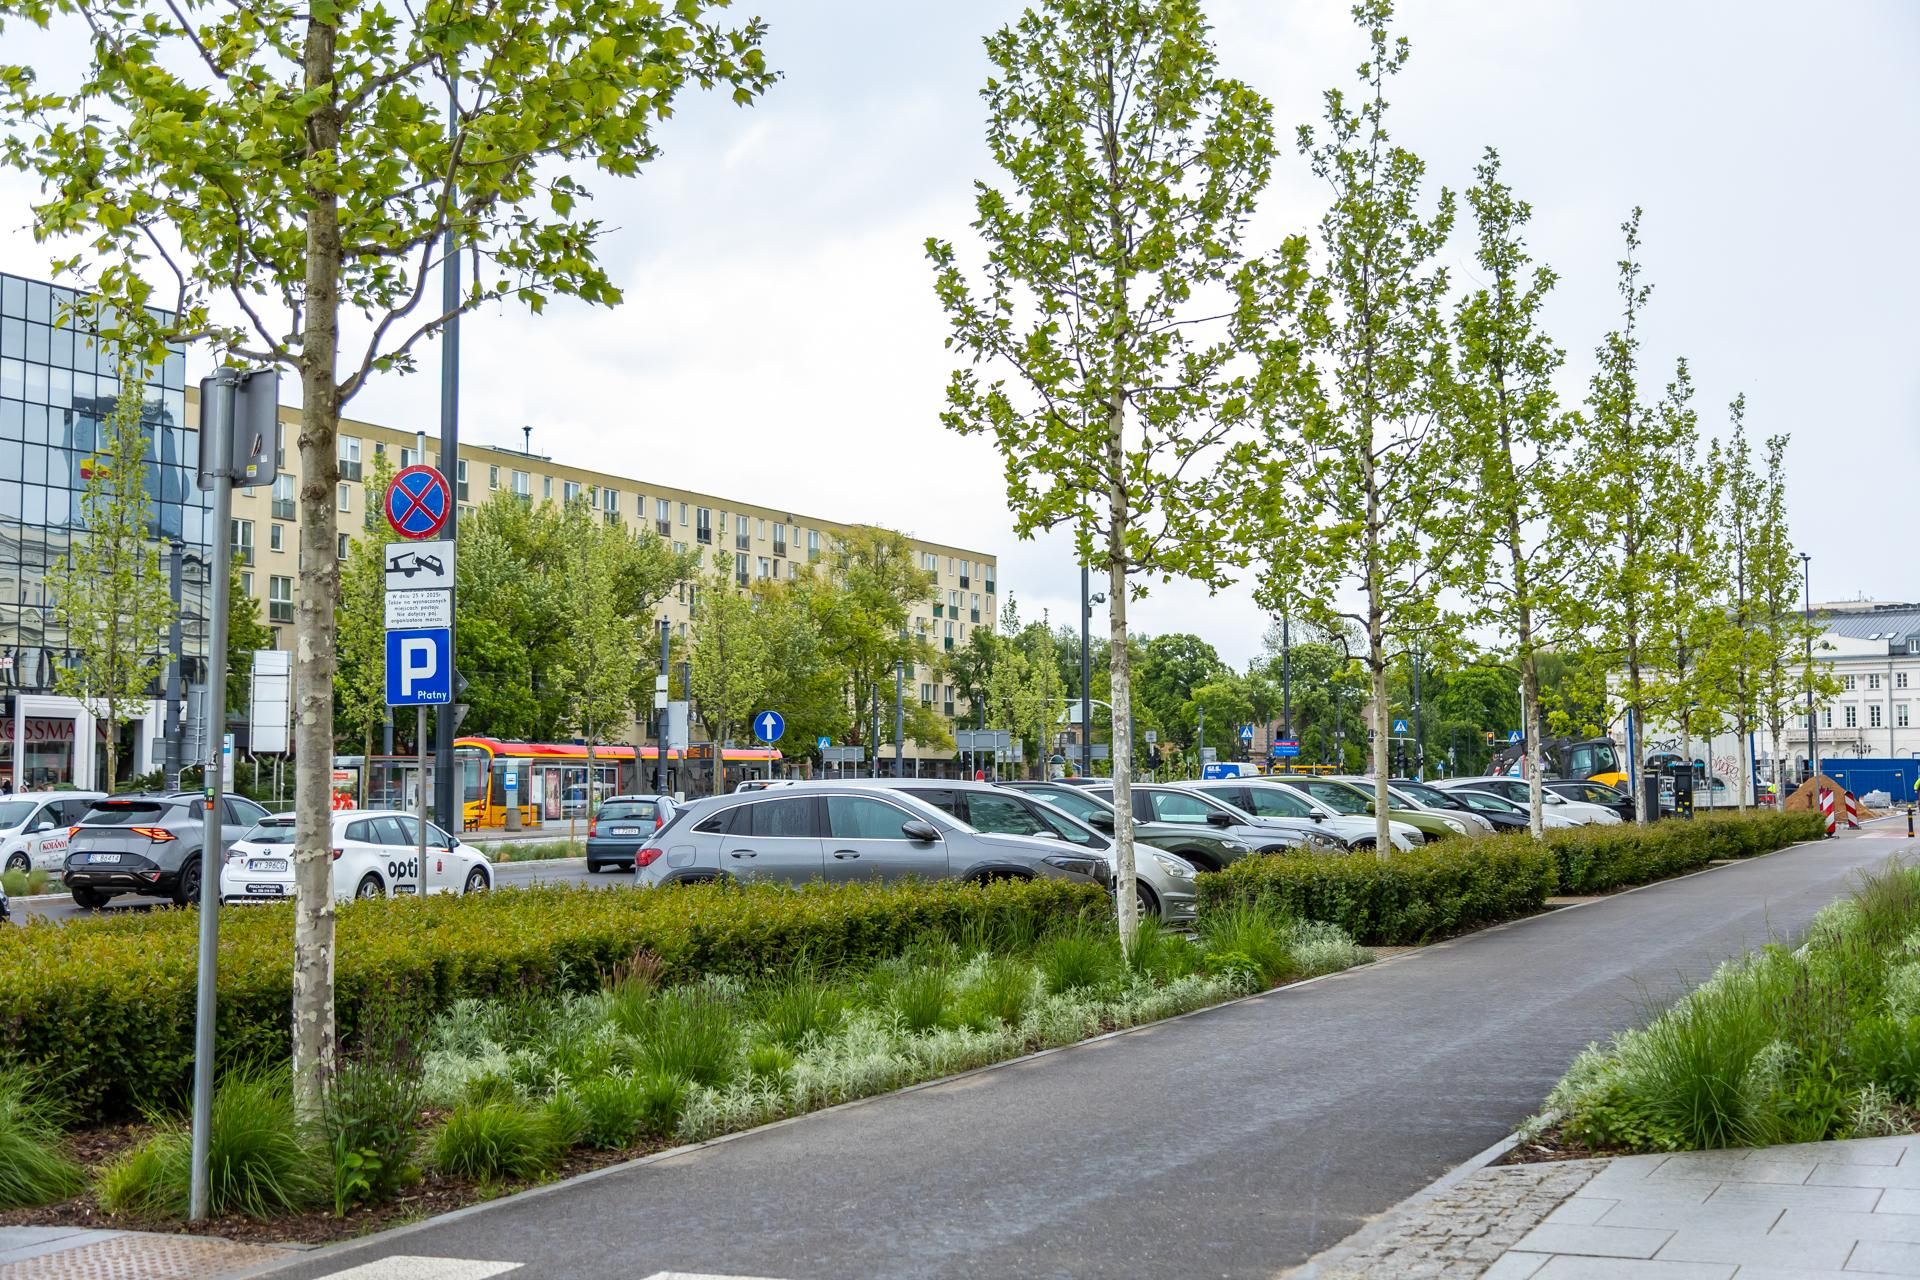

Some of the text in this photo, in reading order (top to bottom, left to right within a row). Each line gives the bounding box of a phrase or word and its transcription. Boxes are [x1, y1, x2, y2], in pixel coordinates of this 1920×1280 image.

[401, 638, 437, 696] P
[417, 690, 447, 701] Płatny
[388, 857, 418, 881] opti
